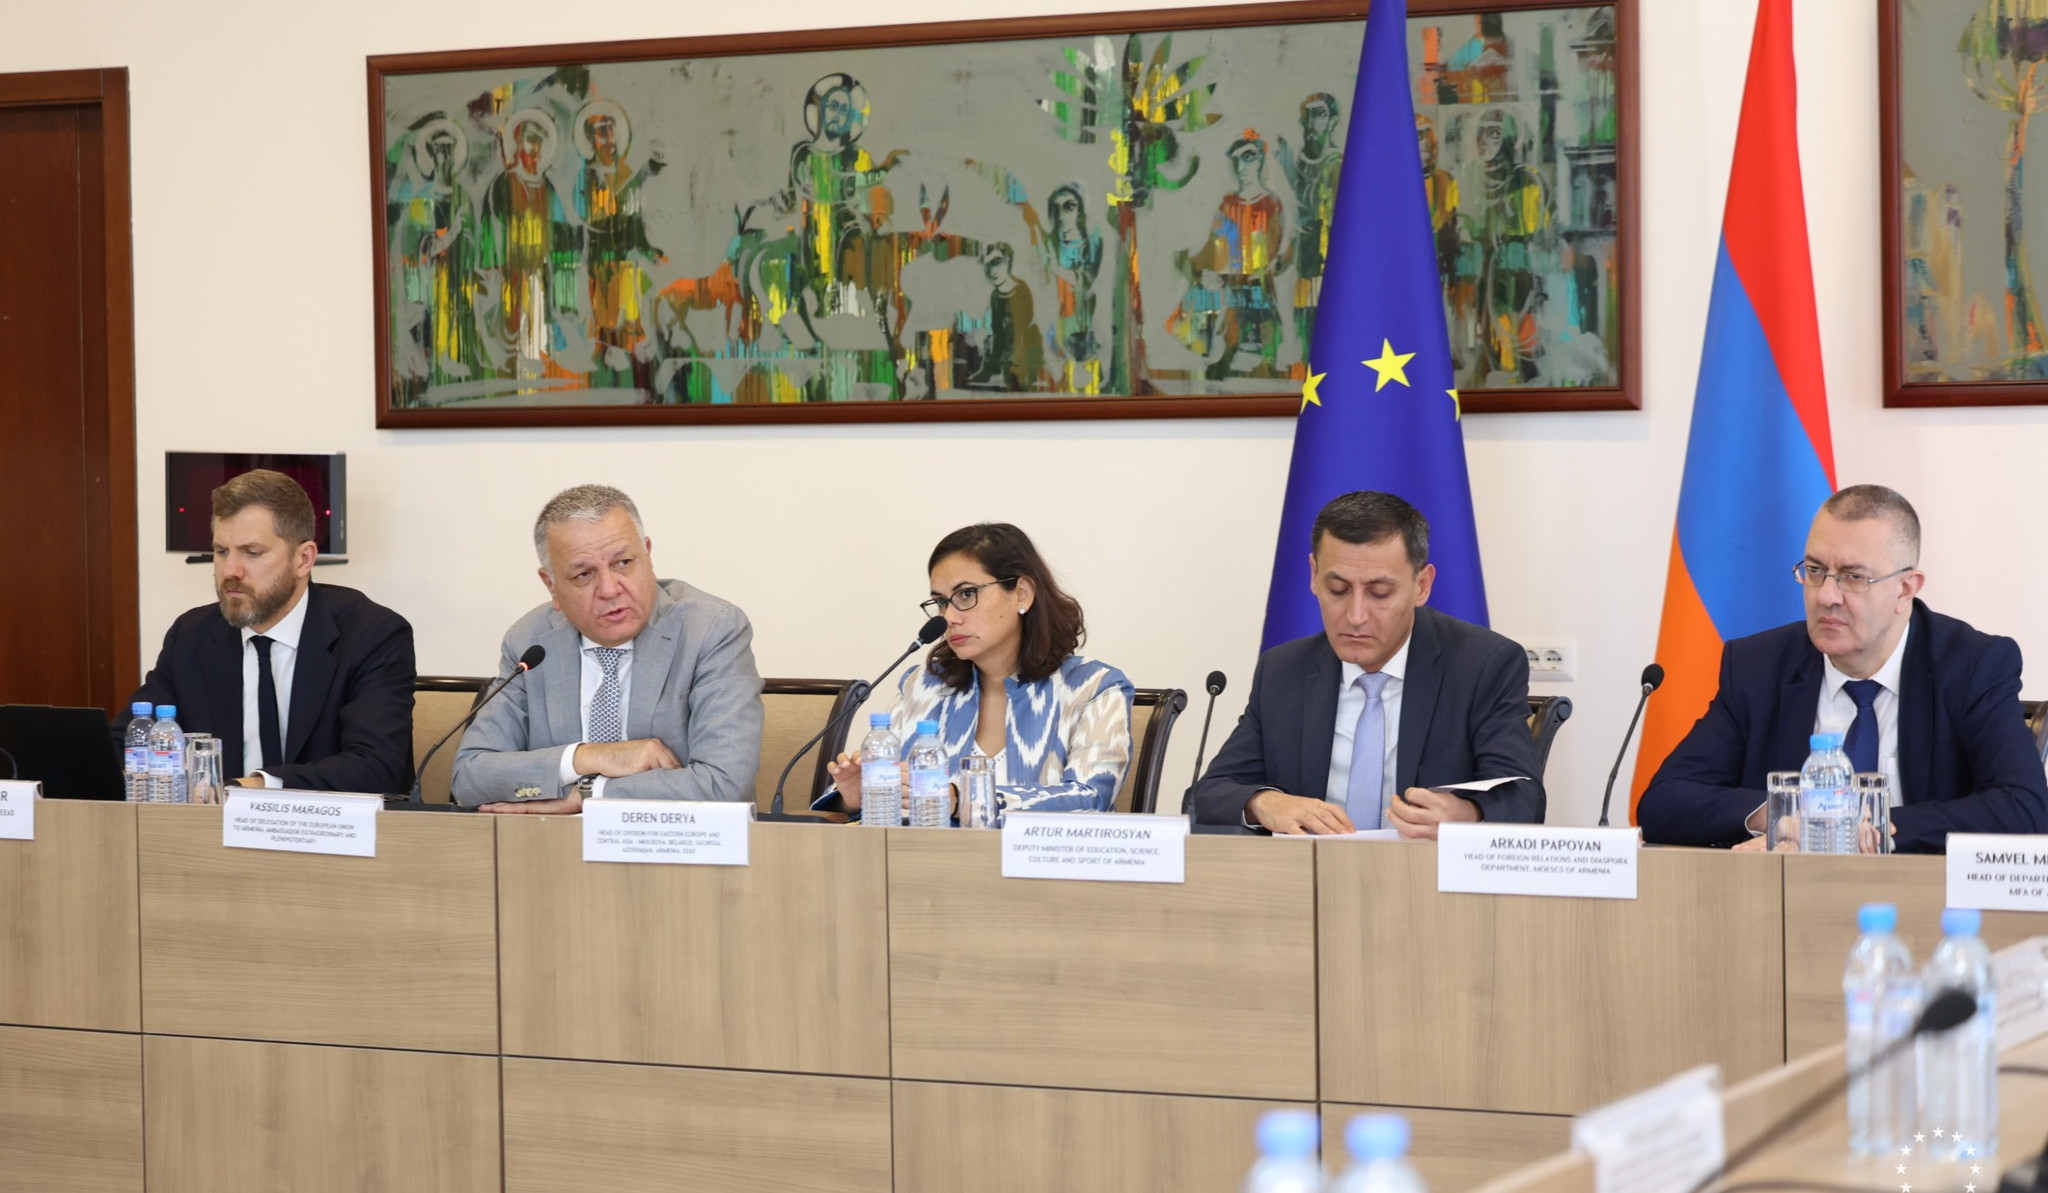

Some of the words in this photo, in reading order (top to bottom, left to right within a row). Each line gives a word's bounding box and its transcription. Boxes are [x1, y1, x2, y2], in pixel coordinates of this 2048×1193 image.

[250, 802, 291, 813] VASSILIS
[292, 805, 342, 816] MARAGOS
[622, 812, 657, 823] DEREN
[660, 812, 696, 824] DERYA
[309, 821, 337, 829] EUROPEAN
[301, 829, 344, 837] EXTRAORDINARY
[1024, 826, 1063, 837] ARTUR
[1066, 827, 1151, 840] MARTIROSYAN
[271, 835, 316, 844] PLENIPOTENTIARY
[1490, 838, 1537, 850] ARKADI
[1541, 839, 1601, 852] PAPOYAN
[1086, 846, 1128, 855] EDUCATION,
[1129, 847, 1161, 856] SCIENCE,
[1029, 855, 1060, 863] CULTURE
[1062, 856, 1076, 864] AND
[1114, 858, 1146, 866] ARMENIA
[1498, 854, 1529, 862] FOREIGN
[1531, 855, 1571, 863] RELATIONS
[1573, 856, 1589, 864] AND
[1590, 857, 1628, 865] DIASPORA
[1975, 851, 2029, 865] SAMVEL
[1481, 863, 1532, 873] DEPARTMENT,
[1533, 865, 1564, 873] MOESCS
[1578, 866, 1611, 875] ARMENIA
[1967, 872, 1992, 881] HEAD
[1995, 873, 2006, 882] OF
[2009, 888, 2028, 897] MFA
[2031, 888, 2043, 897] OF
